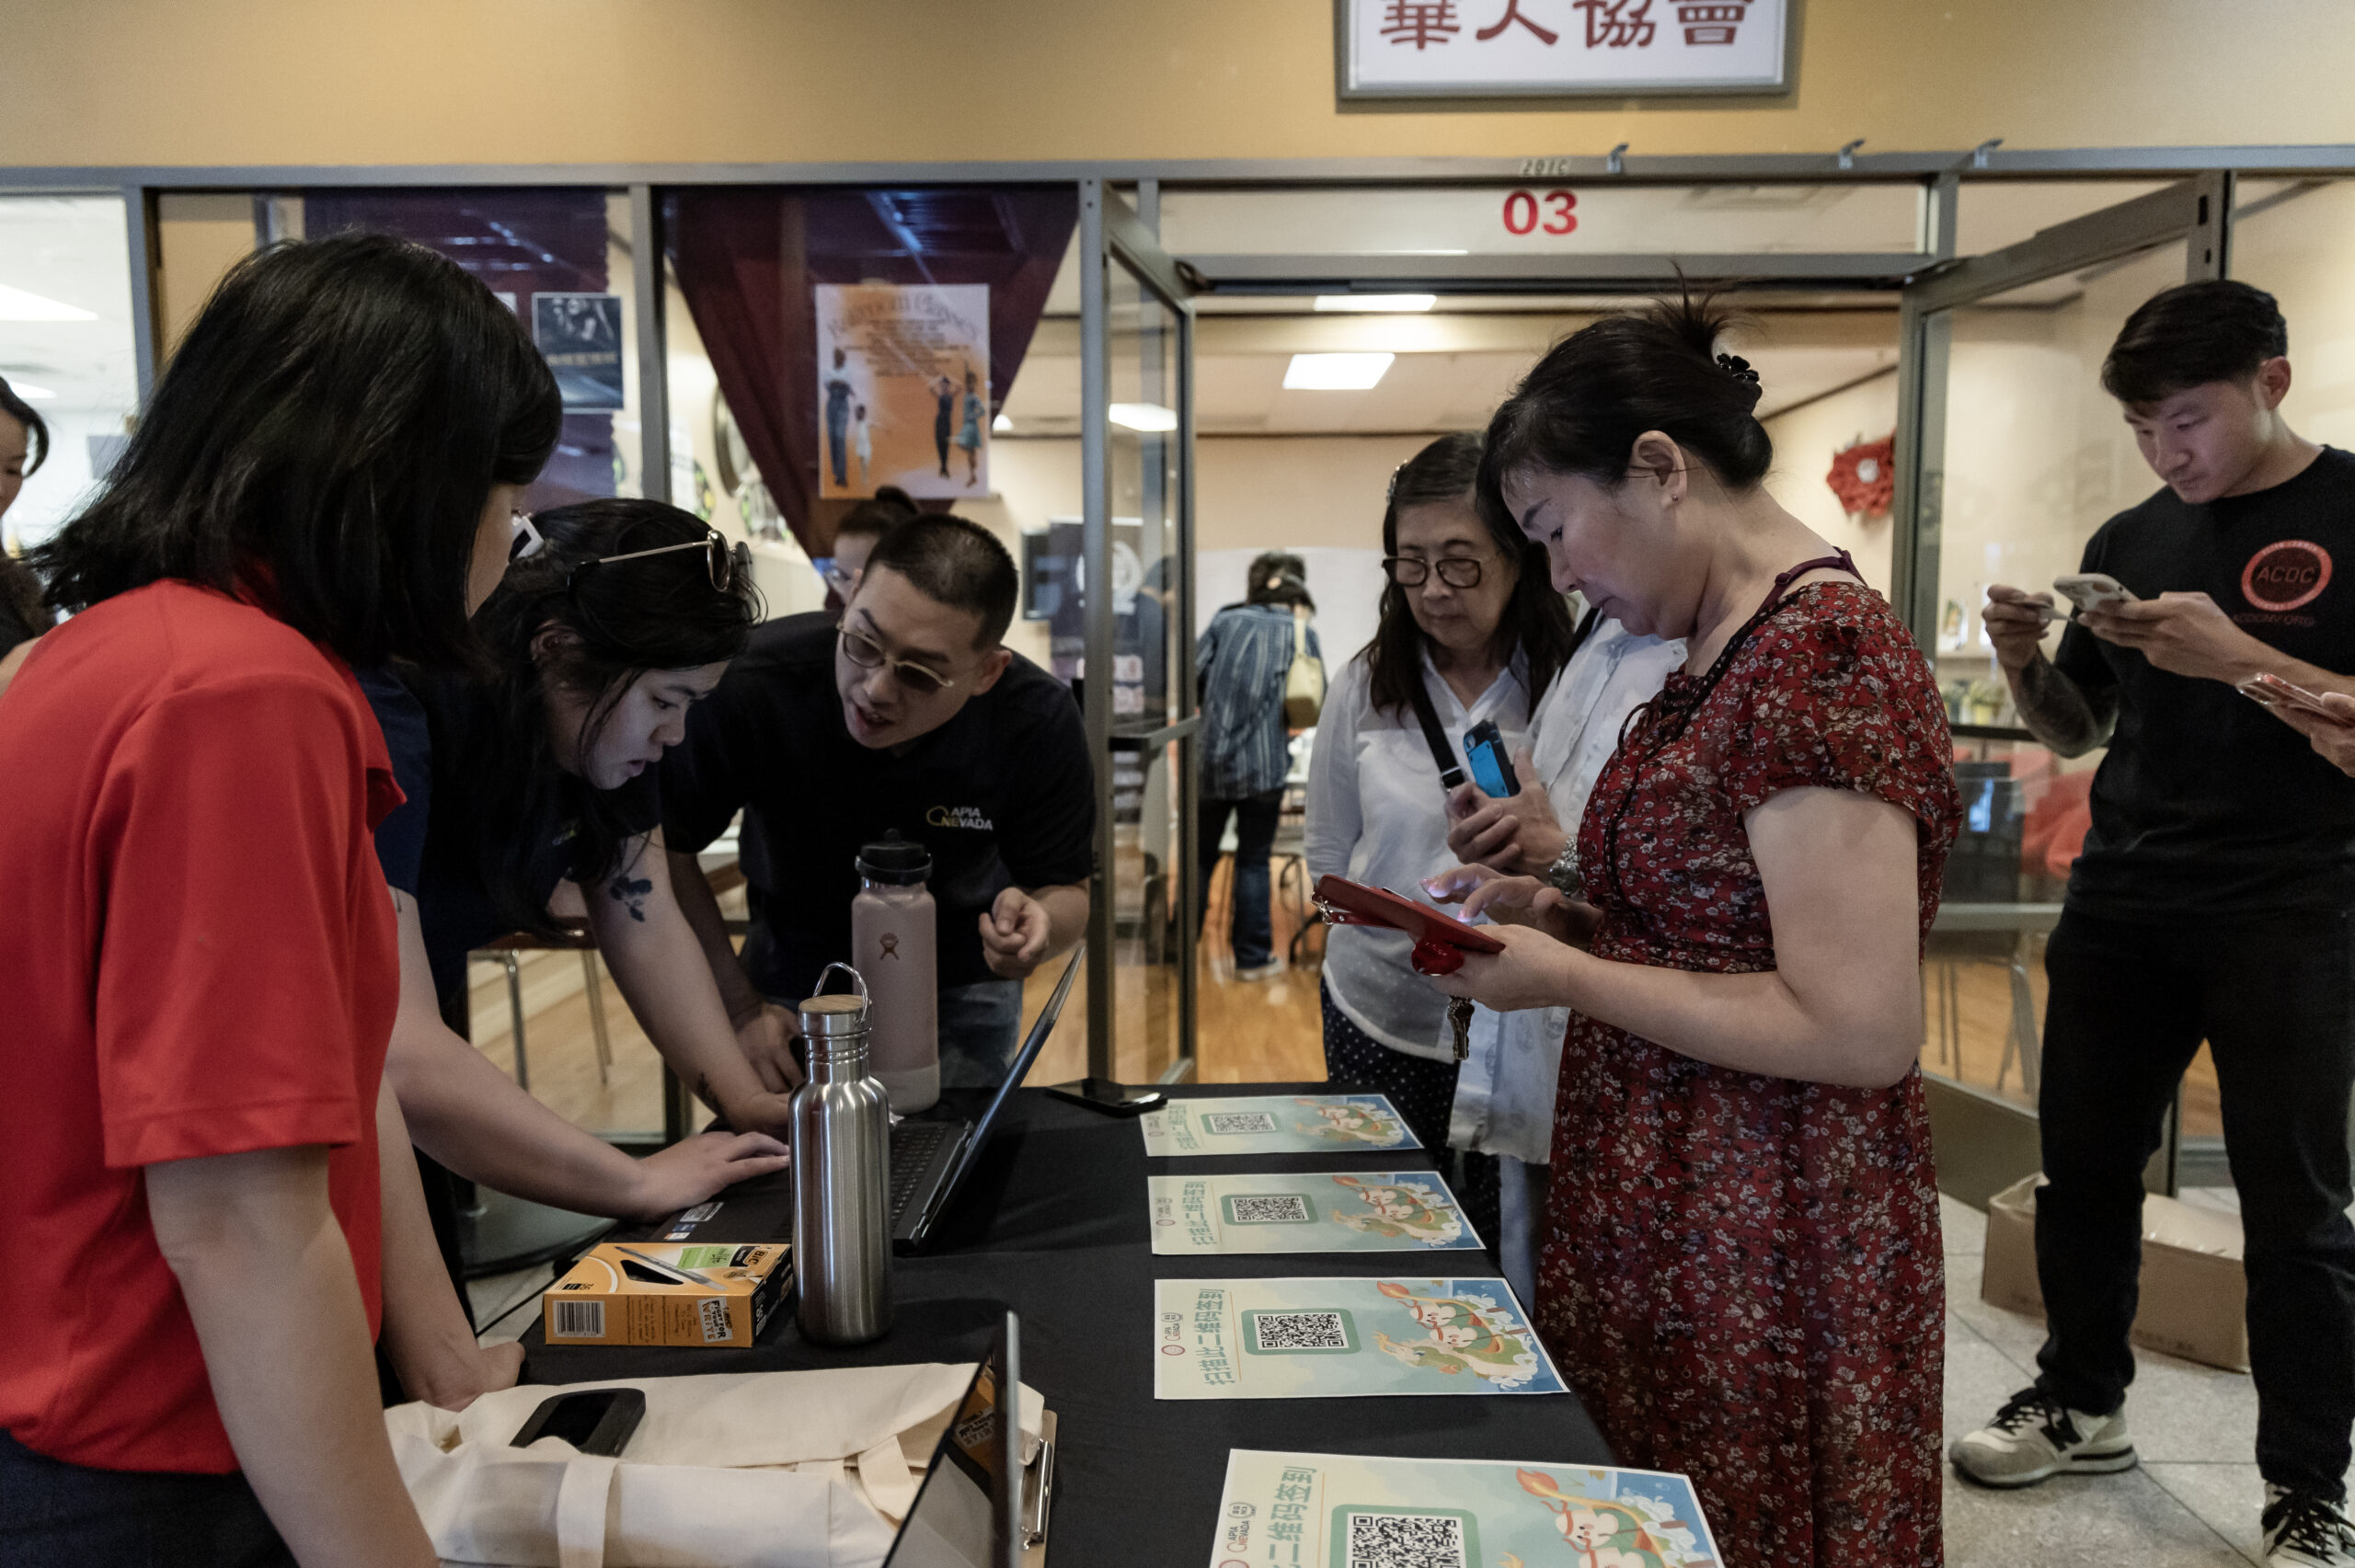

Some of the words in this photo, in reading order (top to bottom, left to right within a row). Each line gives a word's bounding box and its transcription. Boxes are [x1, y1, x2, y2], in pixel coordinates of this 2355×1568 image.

[1503, 189, 1579, 235] 03
[2256, 566, 2315, 583] ACDC
[951, 807, 981, 818] APIA
[942, 816, 994, 830] NEVADA
[1194, 1288, 1235, 1386] 扫描此二维码签到
